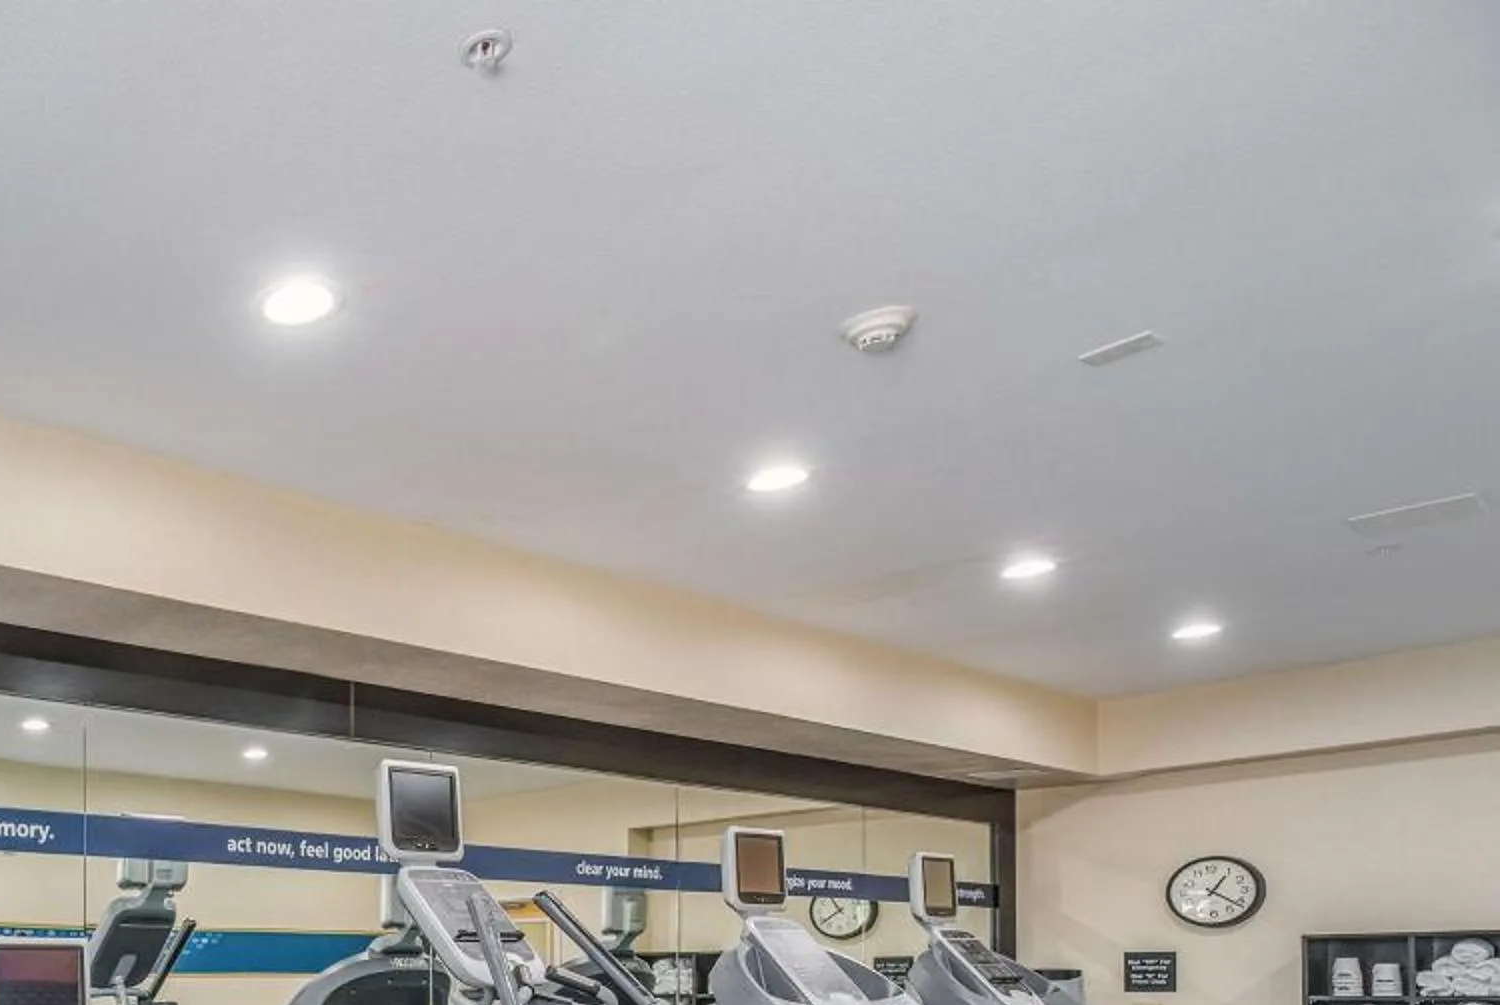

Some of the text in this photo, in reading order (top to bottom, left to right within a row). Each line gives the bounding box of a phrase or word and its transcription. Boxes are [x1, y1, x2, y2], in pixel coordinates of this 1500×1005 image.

[227, 837, 252, 853] act
[257, 840, 295, 859] now,
[300, 840, 329, 859] feel
[333, 845, 371, 863] good
[575, 860, 664, 881] clear your mind.
